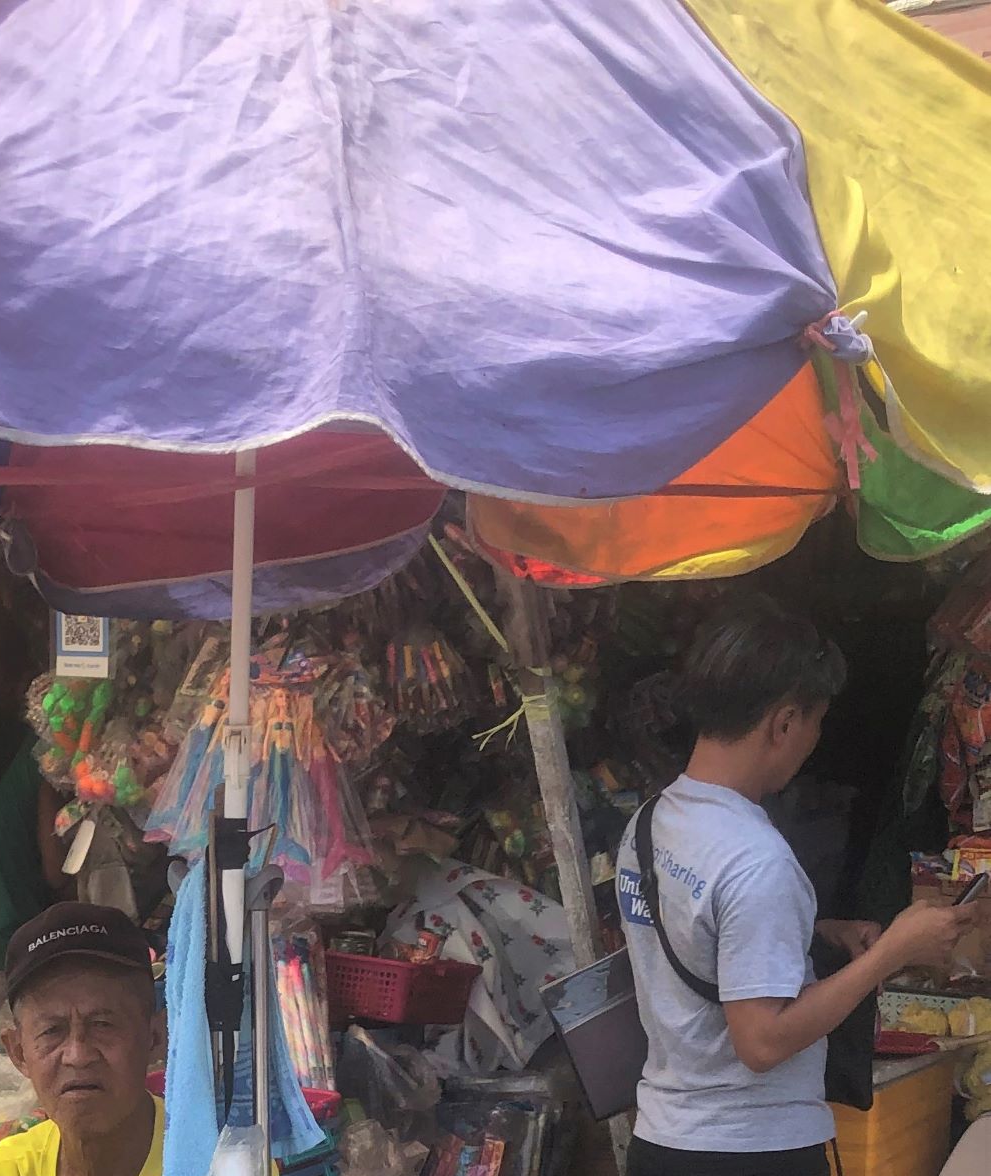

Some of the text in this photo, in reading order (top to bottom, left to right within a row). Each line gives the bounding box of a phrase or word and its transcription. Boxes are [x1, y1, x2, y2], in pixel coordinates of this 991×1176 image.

[619, 874, 644, 898] Uni
[660, 848, 707, 900] Sharing
[28, 924, 109, 953] BALENCIAGA
